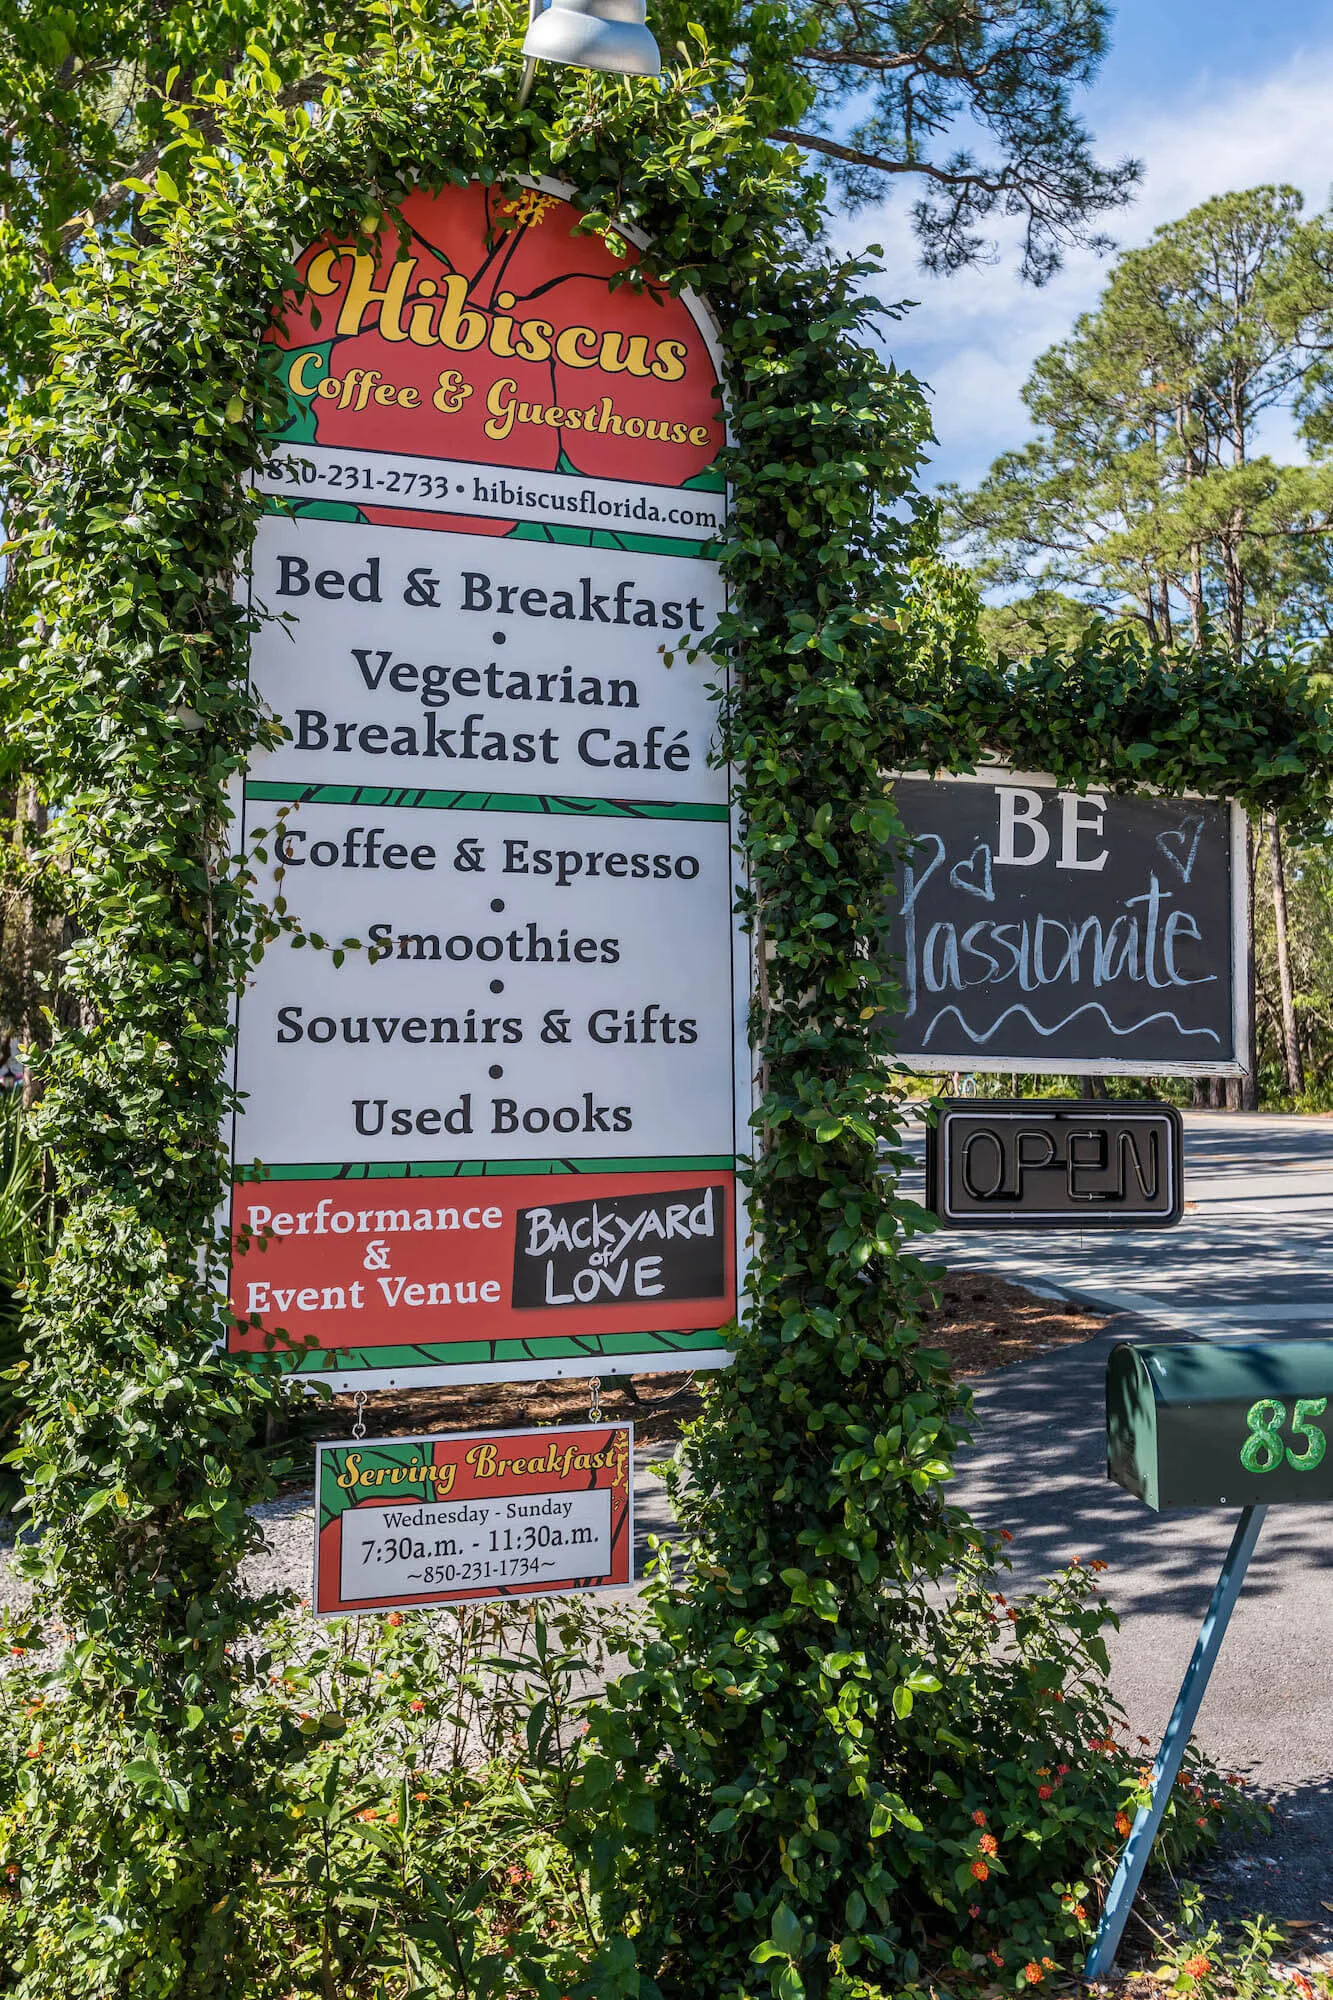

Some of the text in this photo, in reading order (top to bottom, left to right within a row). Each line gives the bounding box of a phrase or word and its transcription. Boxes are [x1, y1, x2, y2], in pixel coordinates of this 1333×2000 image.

[307, 244, 688, 382] Hibiscus
[288, 351, 711, 447] Coffee & Guesthouse
[472, 478, 717, 528] hibiscusflorida.com
[276, 555, 705, 632] Bed & Breakfast
[350, 648, 640, 708] Vegetarian
[294, 709, 691, 773] Breakfast Café
[993, 786, 1110, 871] BE
[274, 827, 701, 886] Coffee & Espresso
[368, 922, 621, 964] Smoothies
[900, 833, 1218, 1020] Passionate
[277, 1004, 698, 1044] Souvenirs & Gifts
[352, 1092, 633, 1137] Used Books
[961, 1128, 1159, 1201] OPEN
[247, 1199, 502, 1237] Performance
[363, 1239, 391, 1271] &
[545, 1255, 666, 1306] LOVE
[590, 1244, 612, 1267] of
[246, 1276, 501, 1313] Event Venue
[1240, 1397, 1328, 1473] 85
[337, 1443, 618, 1495] Serving Breakfast
[383, 1507, 489, 1529] Wednesday
[506, 1498, 574, 1519] Sunday
[362, 1535, 464, 1565] 7:30a.m.
[488, 1525, 600, 1552] 11:30a.m.
